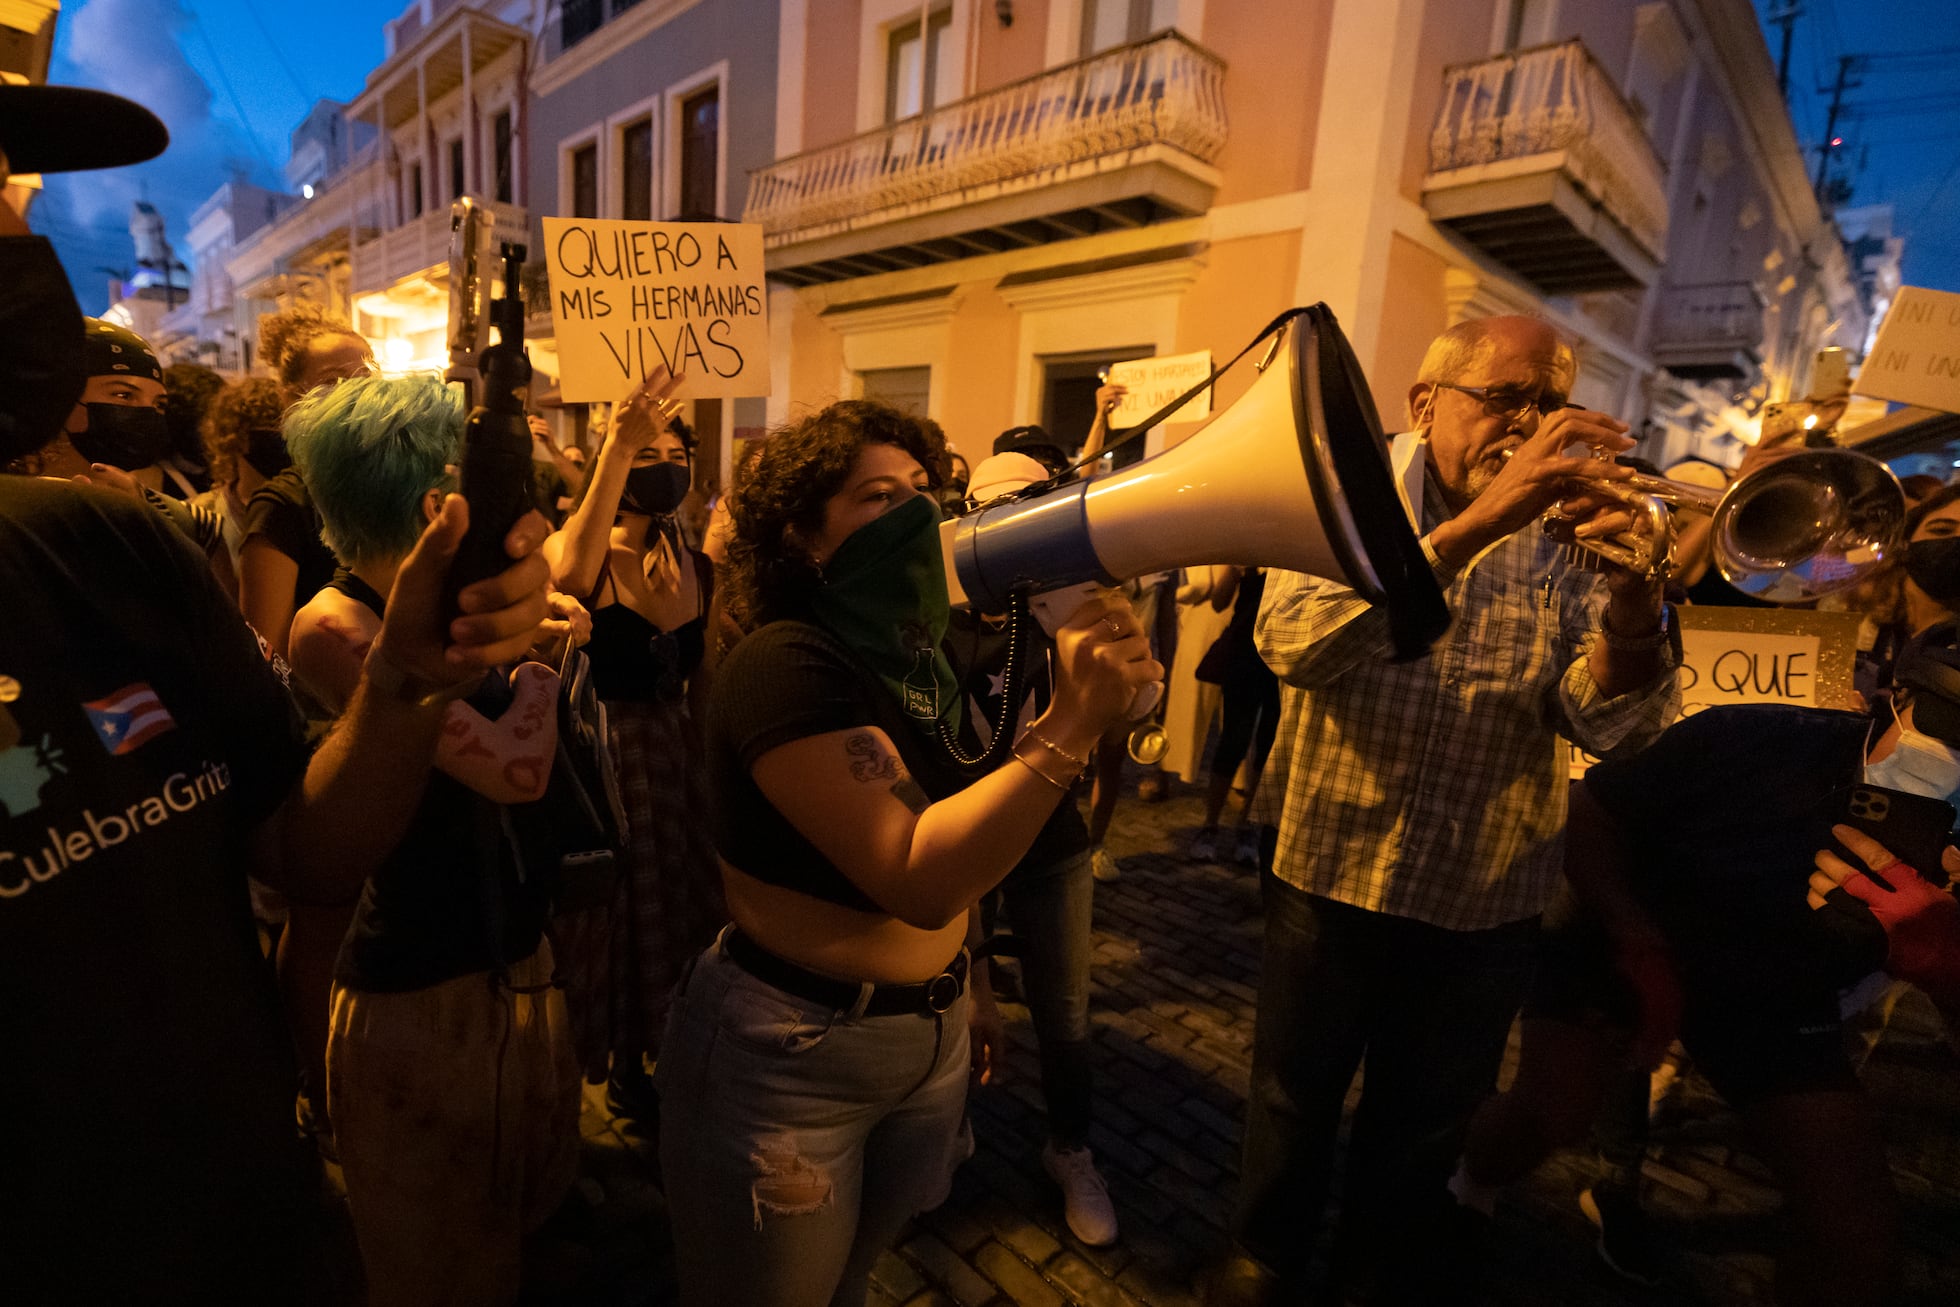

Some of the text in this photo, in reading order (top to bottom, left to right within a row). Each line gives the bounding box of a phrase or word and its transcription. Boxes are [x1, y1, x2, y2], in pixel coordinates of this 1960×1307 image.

[558, 226, 738, 280] QUIERO A
[560, 283, 761, 322] MIS HERMANAS
[599, 319, 744, 384] VIVAS
[1712, 650, 1808, 698] QUE
[909, 690, 932, 704] GRL
[910, 701, 934, 716] PWR
